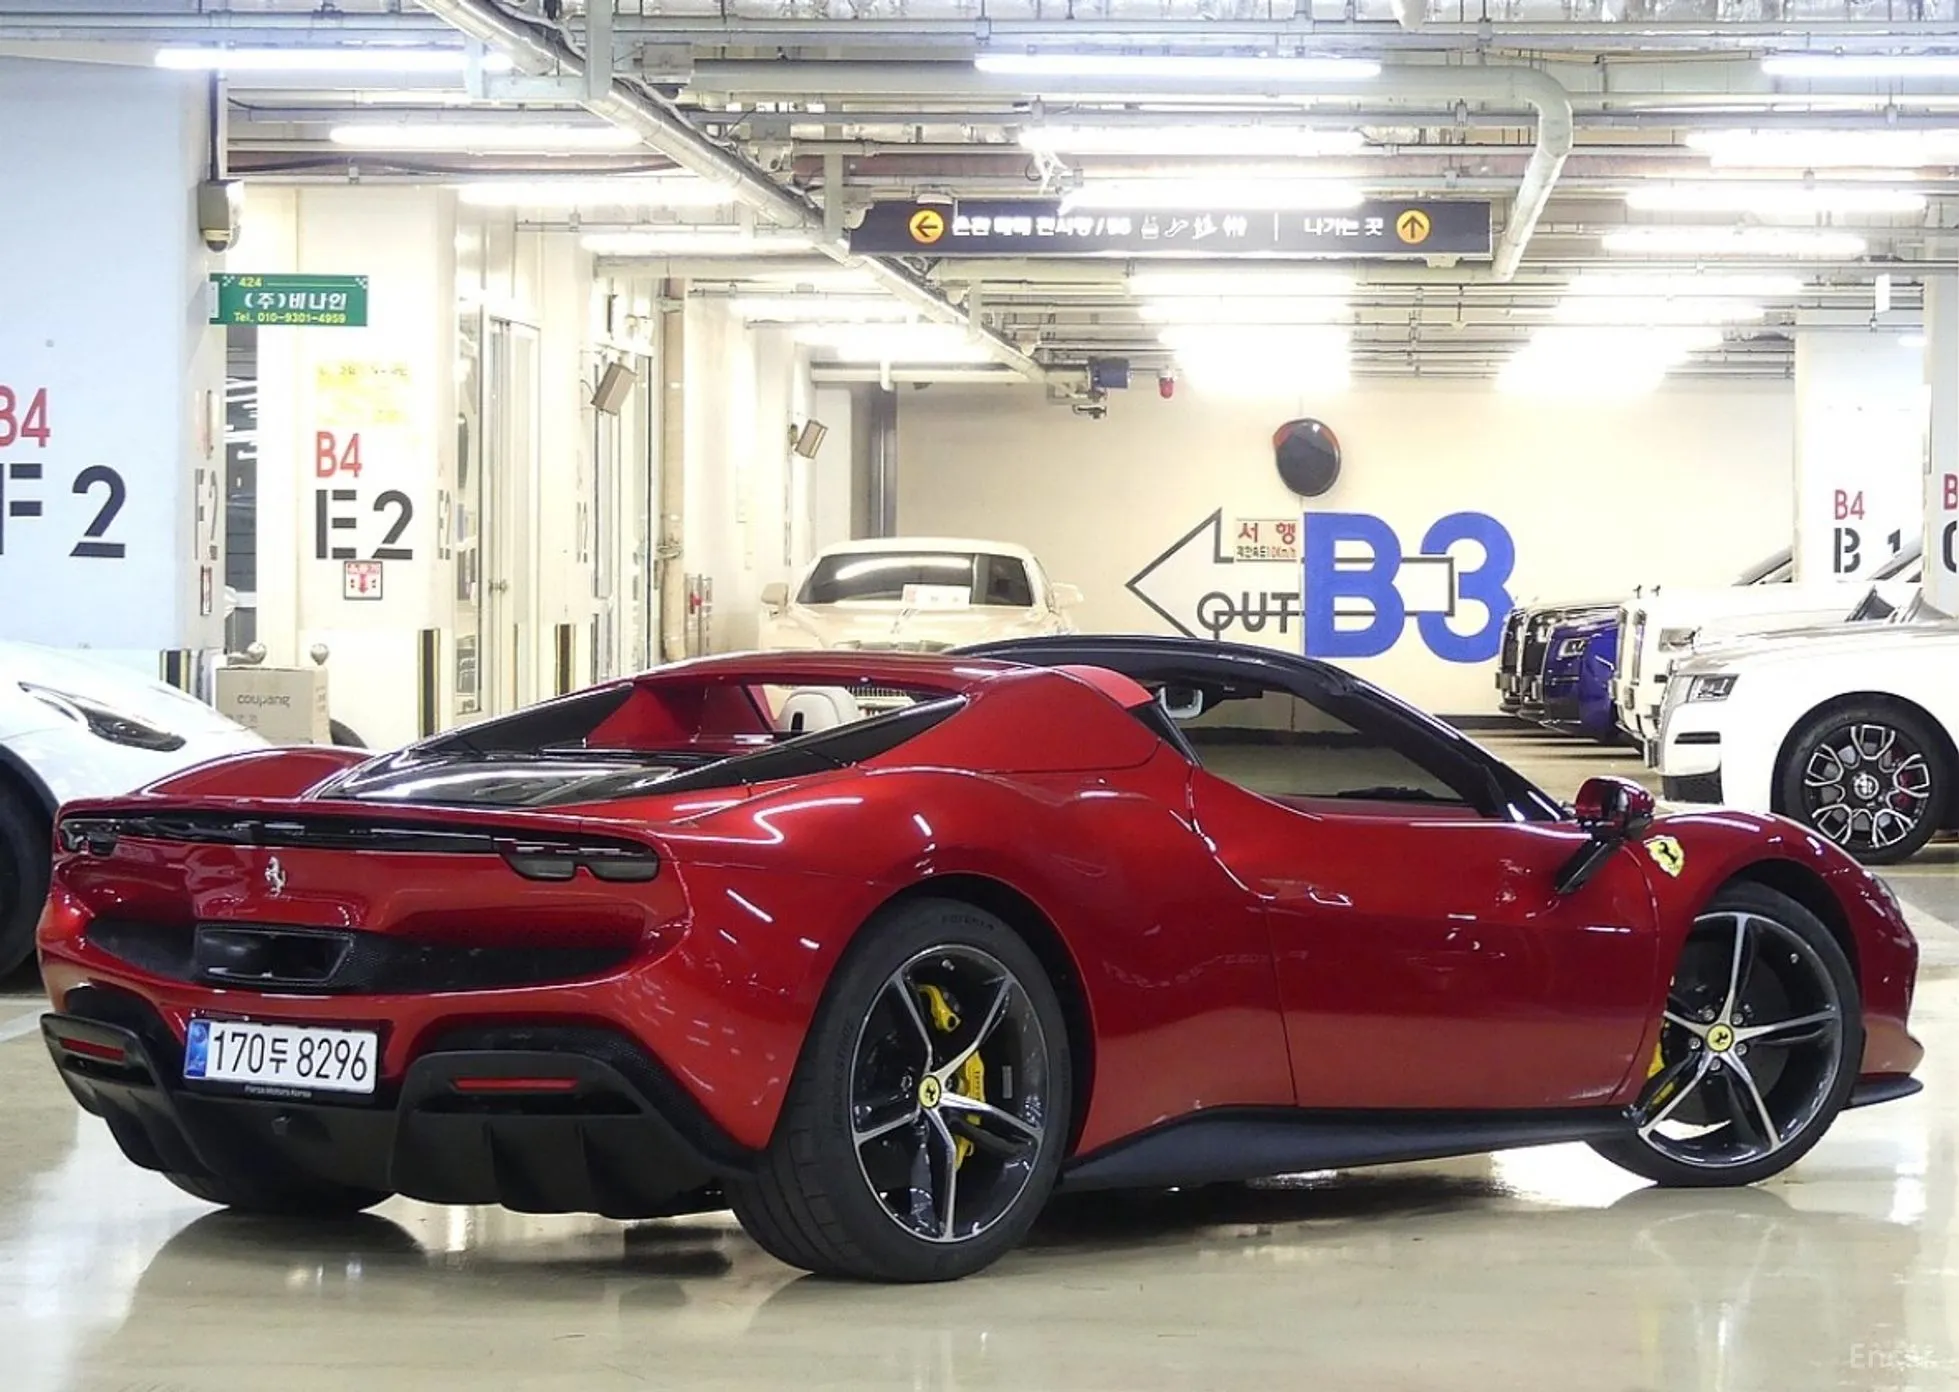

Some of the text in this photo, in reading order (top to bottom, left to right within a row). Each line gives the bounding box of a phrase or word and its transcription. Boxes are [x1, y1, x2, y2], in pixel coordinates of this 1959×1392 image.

[238, 276, 263, 288] 424
[233, 312, 254, 322] Tel.
[315, 431, 363, 478] B4
[1834, 489, 1865, 520] B4
[315, 489, 413, 560] E2
[1304, 511, 1516, 663] B3
[236, 694, 291, 708] coupang
[213, 1030, 368, 1082] 170두 8296
